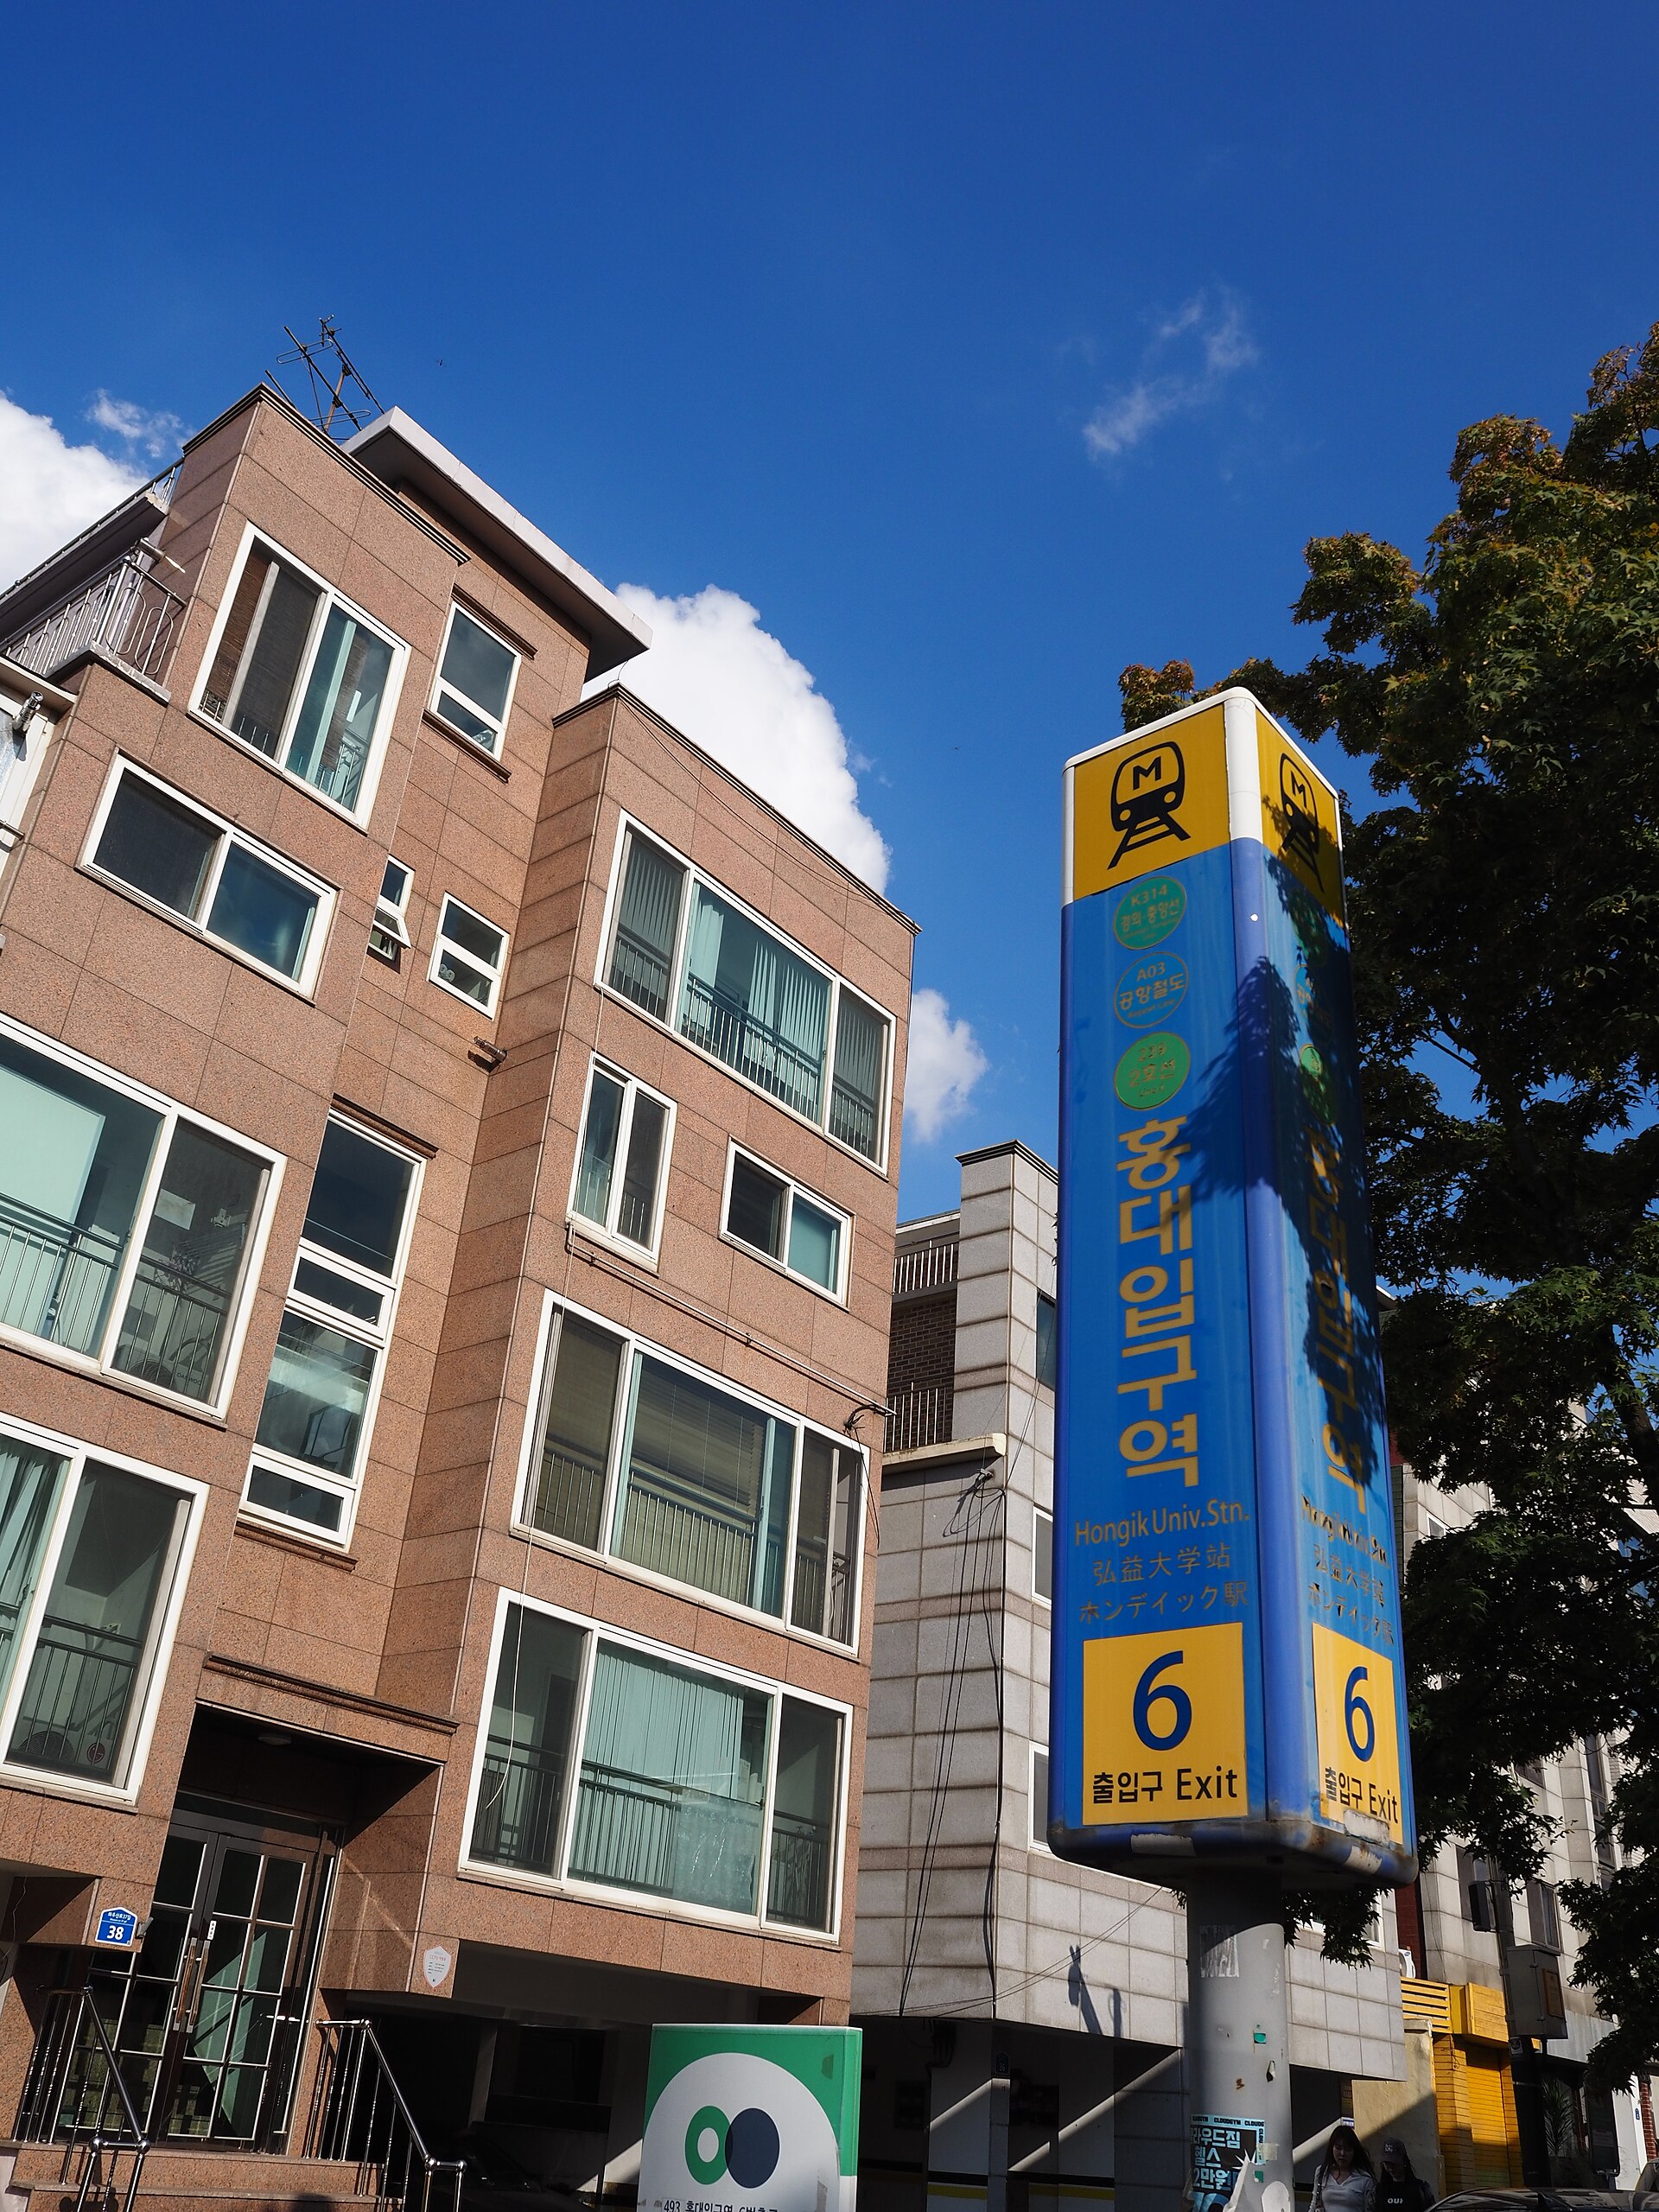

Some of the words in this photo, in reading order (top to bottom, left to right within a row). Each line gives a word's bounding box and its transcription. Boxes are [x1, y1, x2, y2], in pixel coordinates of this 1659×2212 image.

[1133, 756, 1161, 791] M
[1290, 770, 1307, 809] M
[1136, 961, 1166, 982] A03
[1120, 973, 1185, 1011] 공항철도
[1116, 1116, 1199, 1488] 홍대입구역
[1075, 1509, 1149, 1547] Hongik
[1093, 1541, 1230, 1586] 弘益大学站
[1133, 1649, 1192, 1751] 6
[1344, 1666, 1375, 1763] 6
[1093, 1771, 1163, 1804] 출입구
[1177, 1765, 1237, 1800] Exit
[1325, 1767, 1363, 1809] 출입구
[1369, 1783, 1398, 1824] Exit
[106, 1925, 124, 1941] 38
